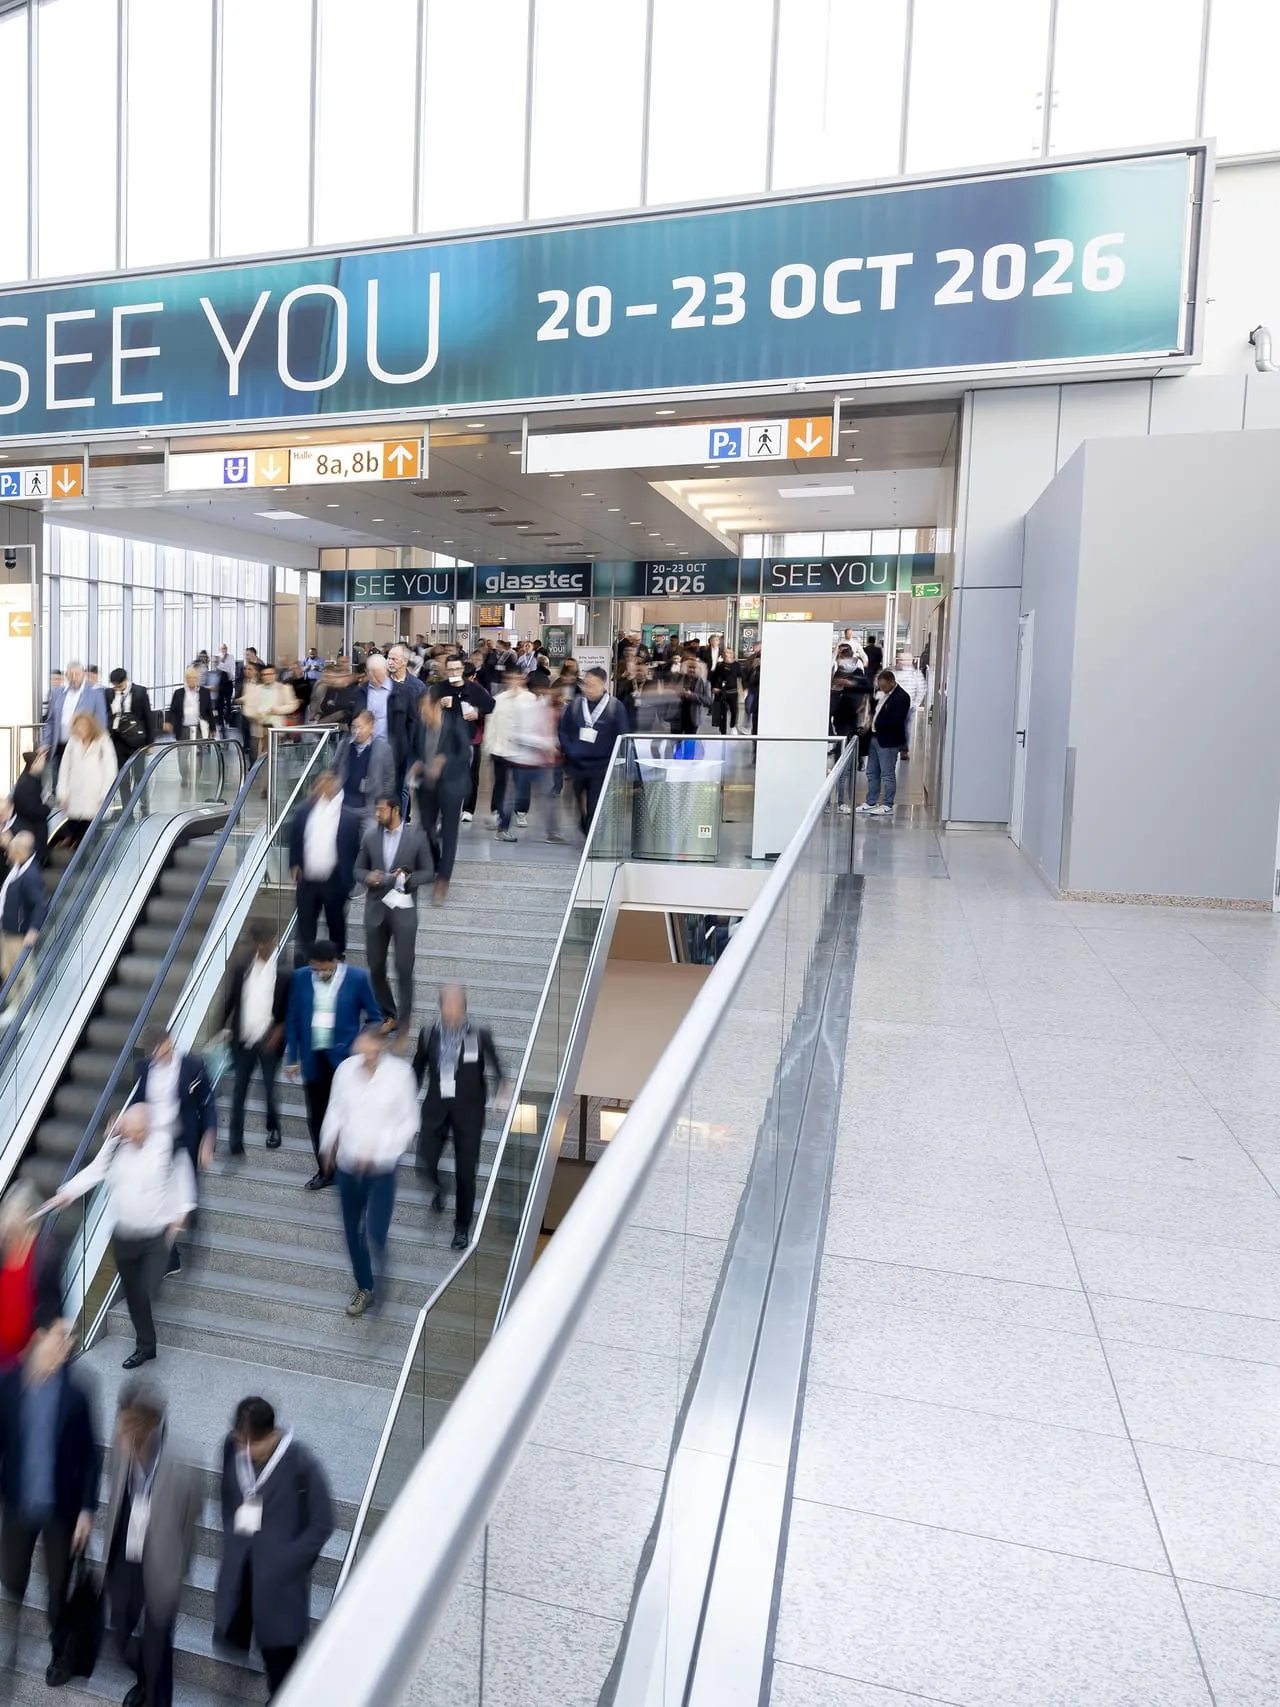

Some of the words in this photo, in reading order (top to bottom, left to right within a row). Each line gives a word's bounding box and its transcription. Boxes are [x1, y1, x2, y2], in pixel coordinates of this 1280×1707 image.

[537, 284, 612, 341] 20
[671, 270, 746, 330] 23
[769, 252, 913, 319] OCT
[934, 232, 1126, 306] 2026
[199, 272, 441, 396] YOU
[293, 451, 313, 460] Halle
[686, 563, 707, 573] OCT
[771, 563, 822, 587] SEE
[830, 562, 888, 585] YOU
[355, 574, 396, 596] SEE
[401, 573, 448, 595] YOU
[485, 570, 584, 594] glasstec
[651, 575, 705, 594] 2026
